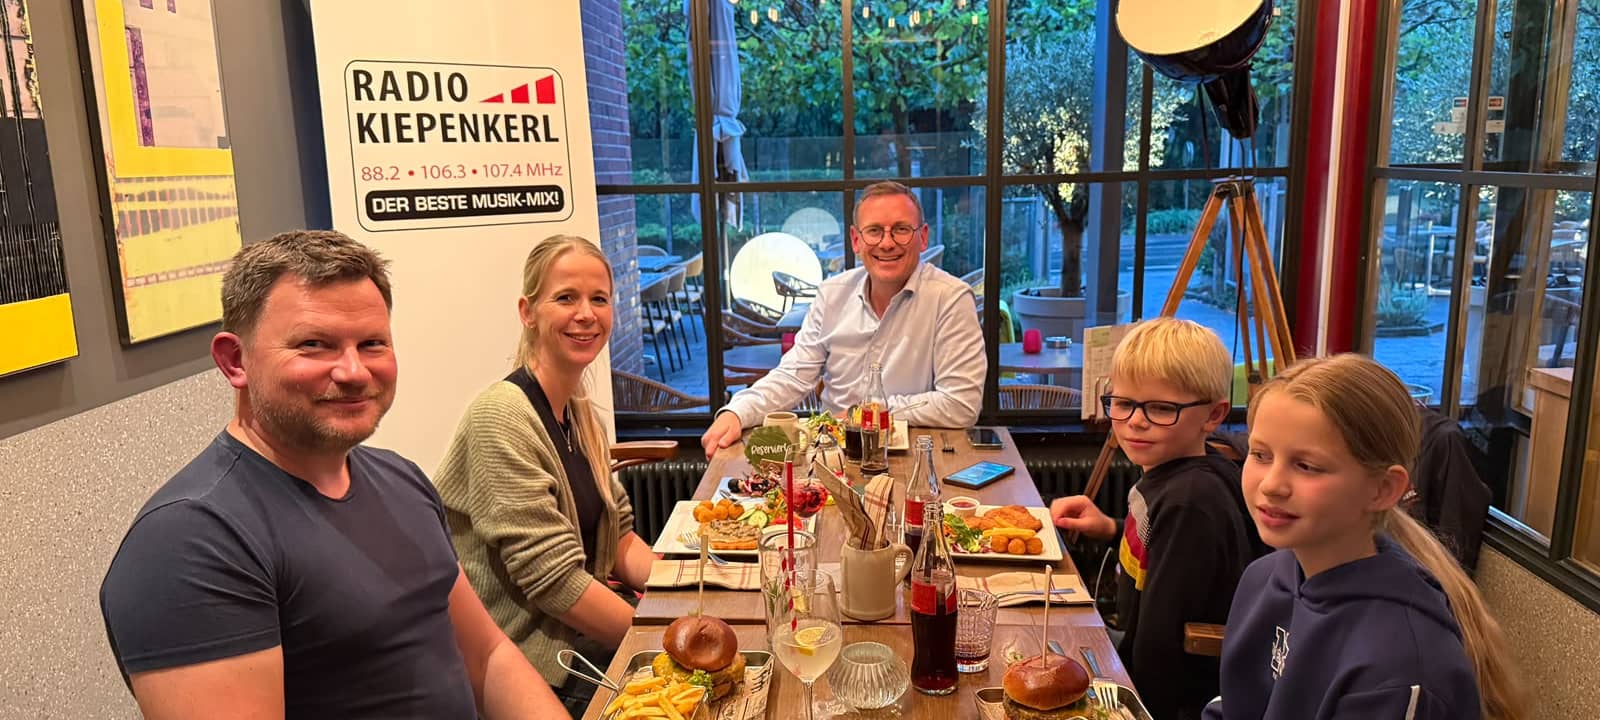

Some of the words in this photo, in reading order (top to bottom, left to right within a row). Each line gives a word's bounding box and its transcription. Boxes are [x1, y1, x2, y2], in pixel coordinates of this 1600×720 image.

[352, 69, 468, 102] RADIO
[357, 112, 559, 143] KIEPENKERL
[361, 166, 400, 181] 88.2
[420, 164, 466, 180] 106.3
[482, 163, 523, 178] 107.4
[526, 162, 563, 177] MHz
[372, 196, 409, 213] DER
[415, 194, 468, 211] BESTE
[472, 191, 560, 209] MUSIK-MIX!
